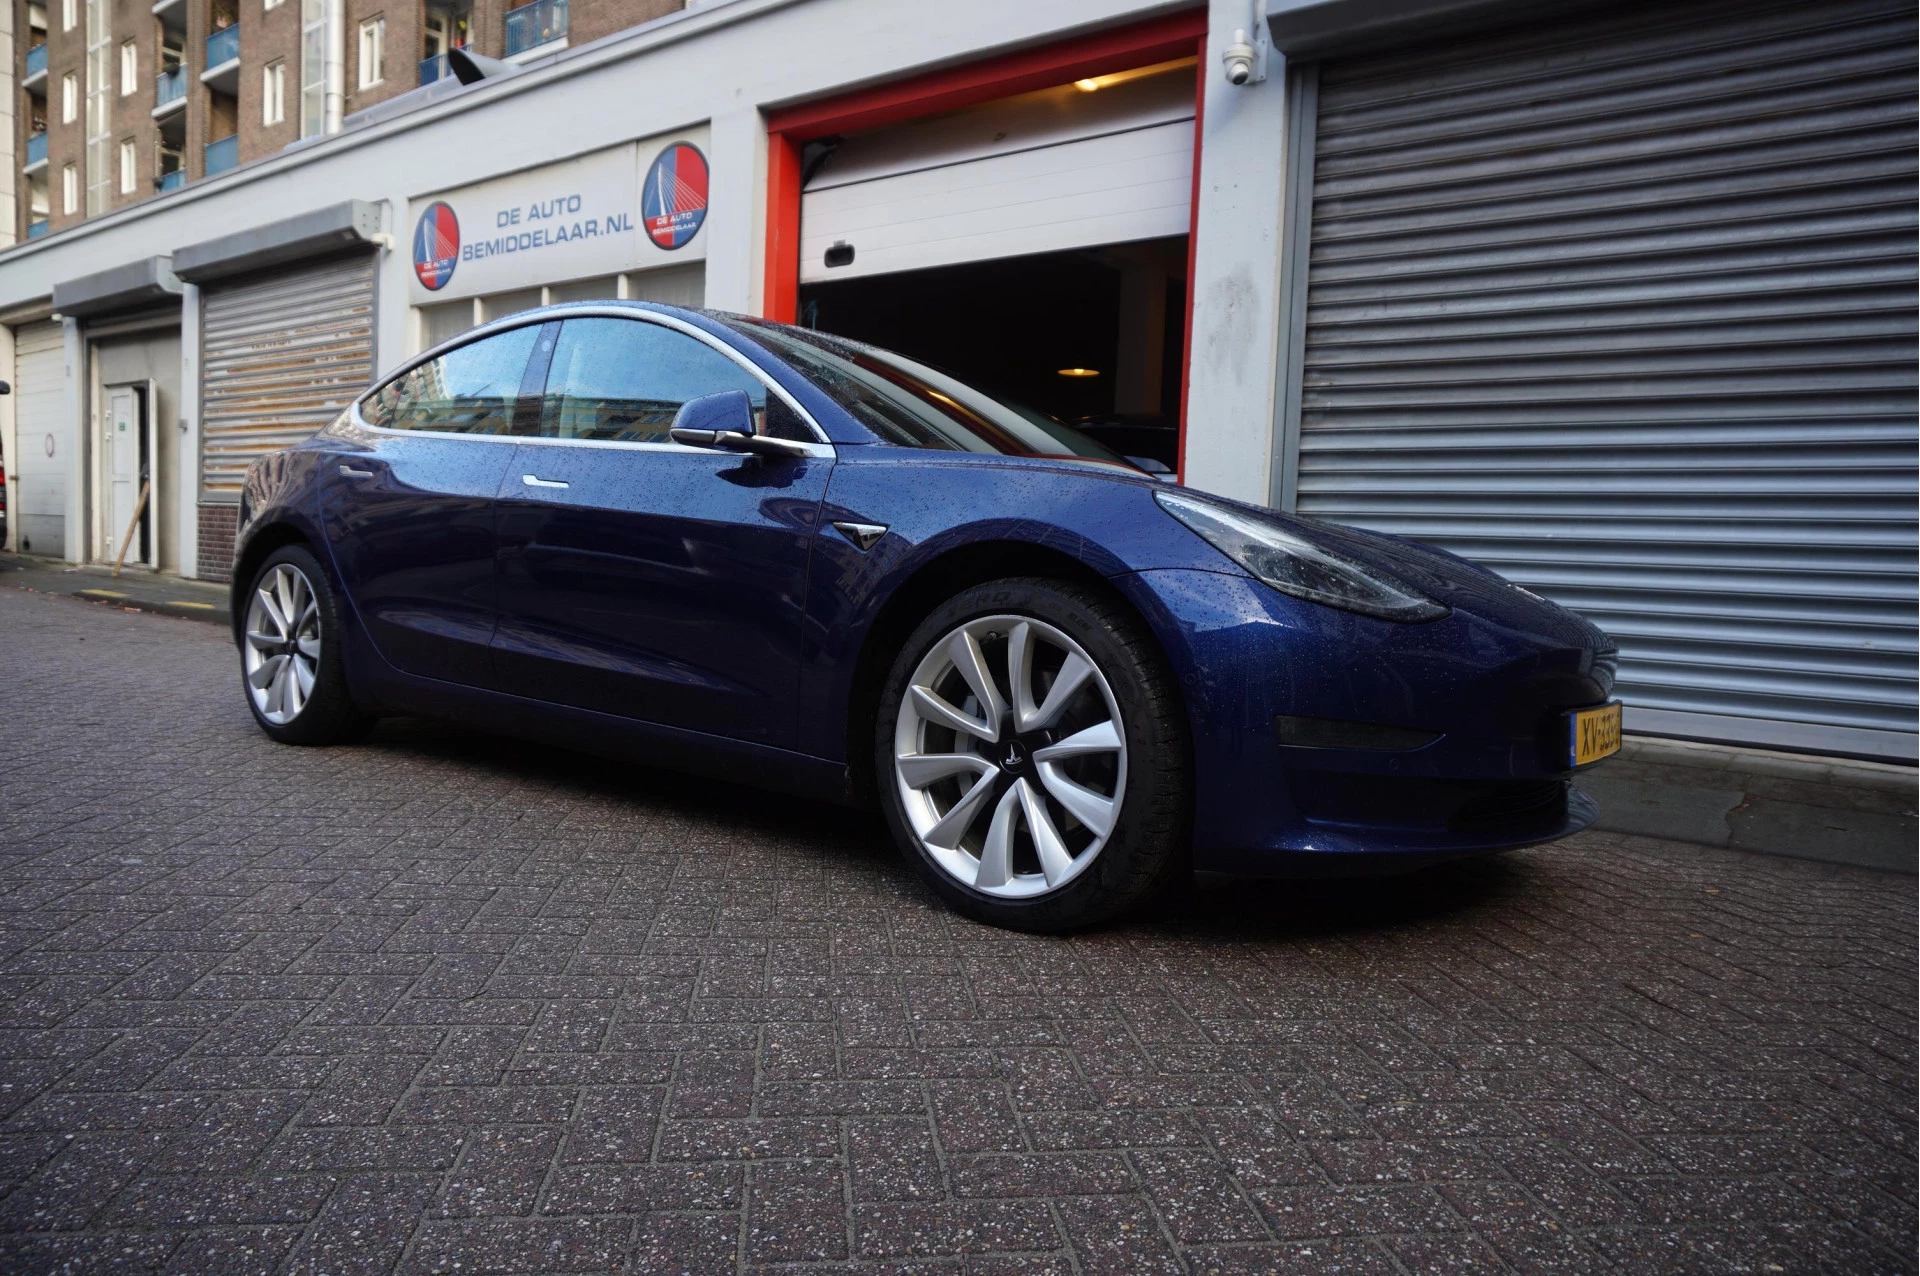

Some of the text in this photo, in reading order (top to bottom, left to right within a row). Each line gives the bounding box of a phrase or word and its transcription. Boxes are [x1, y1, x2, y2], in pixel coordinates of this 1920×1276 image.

[497, 194, 582, 228] DE AUTO
[656, 212, 693, 225] DE AUTO
[462, 213, 634, 262] BEMIDDELAAR.NL
[652, 221, 697, 235] BEMIDDELAAR
